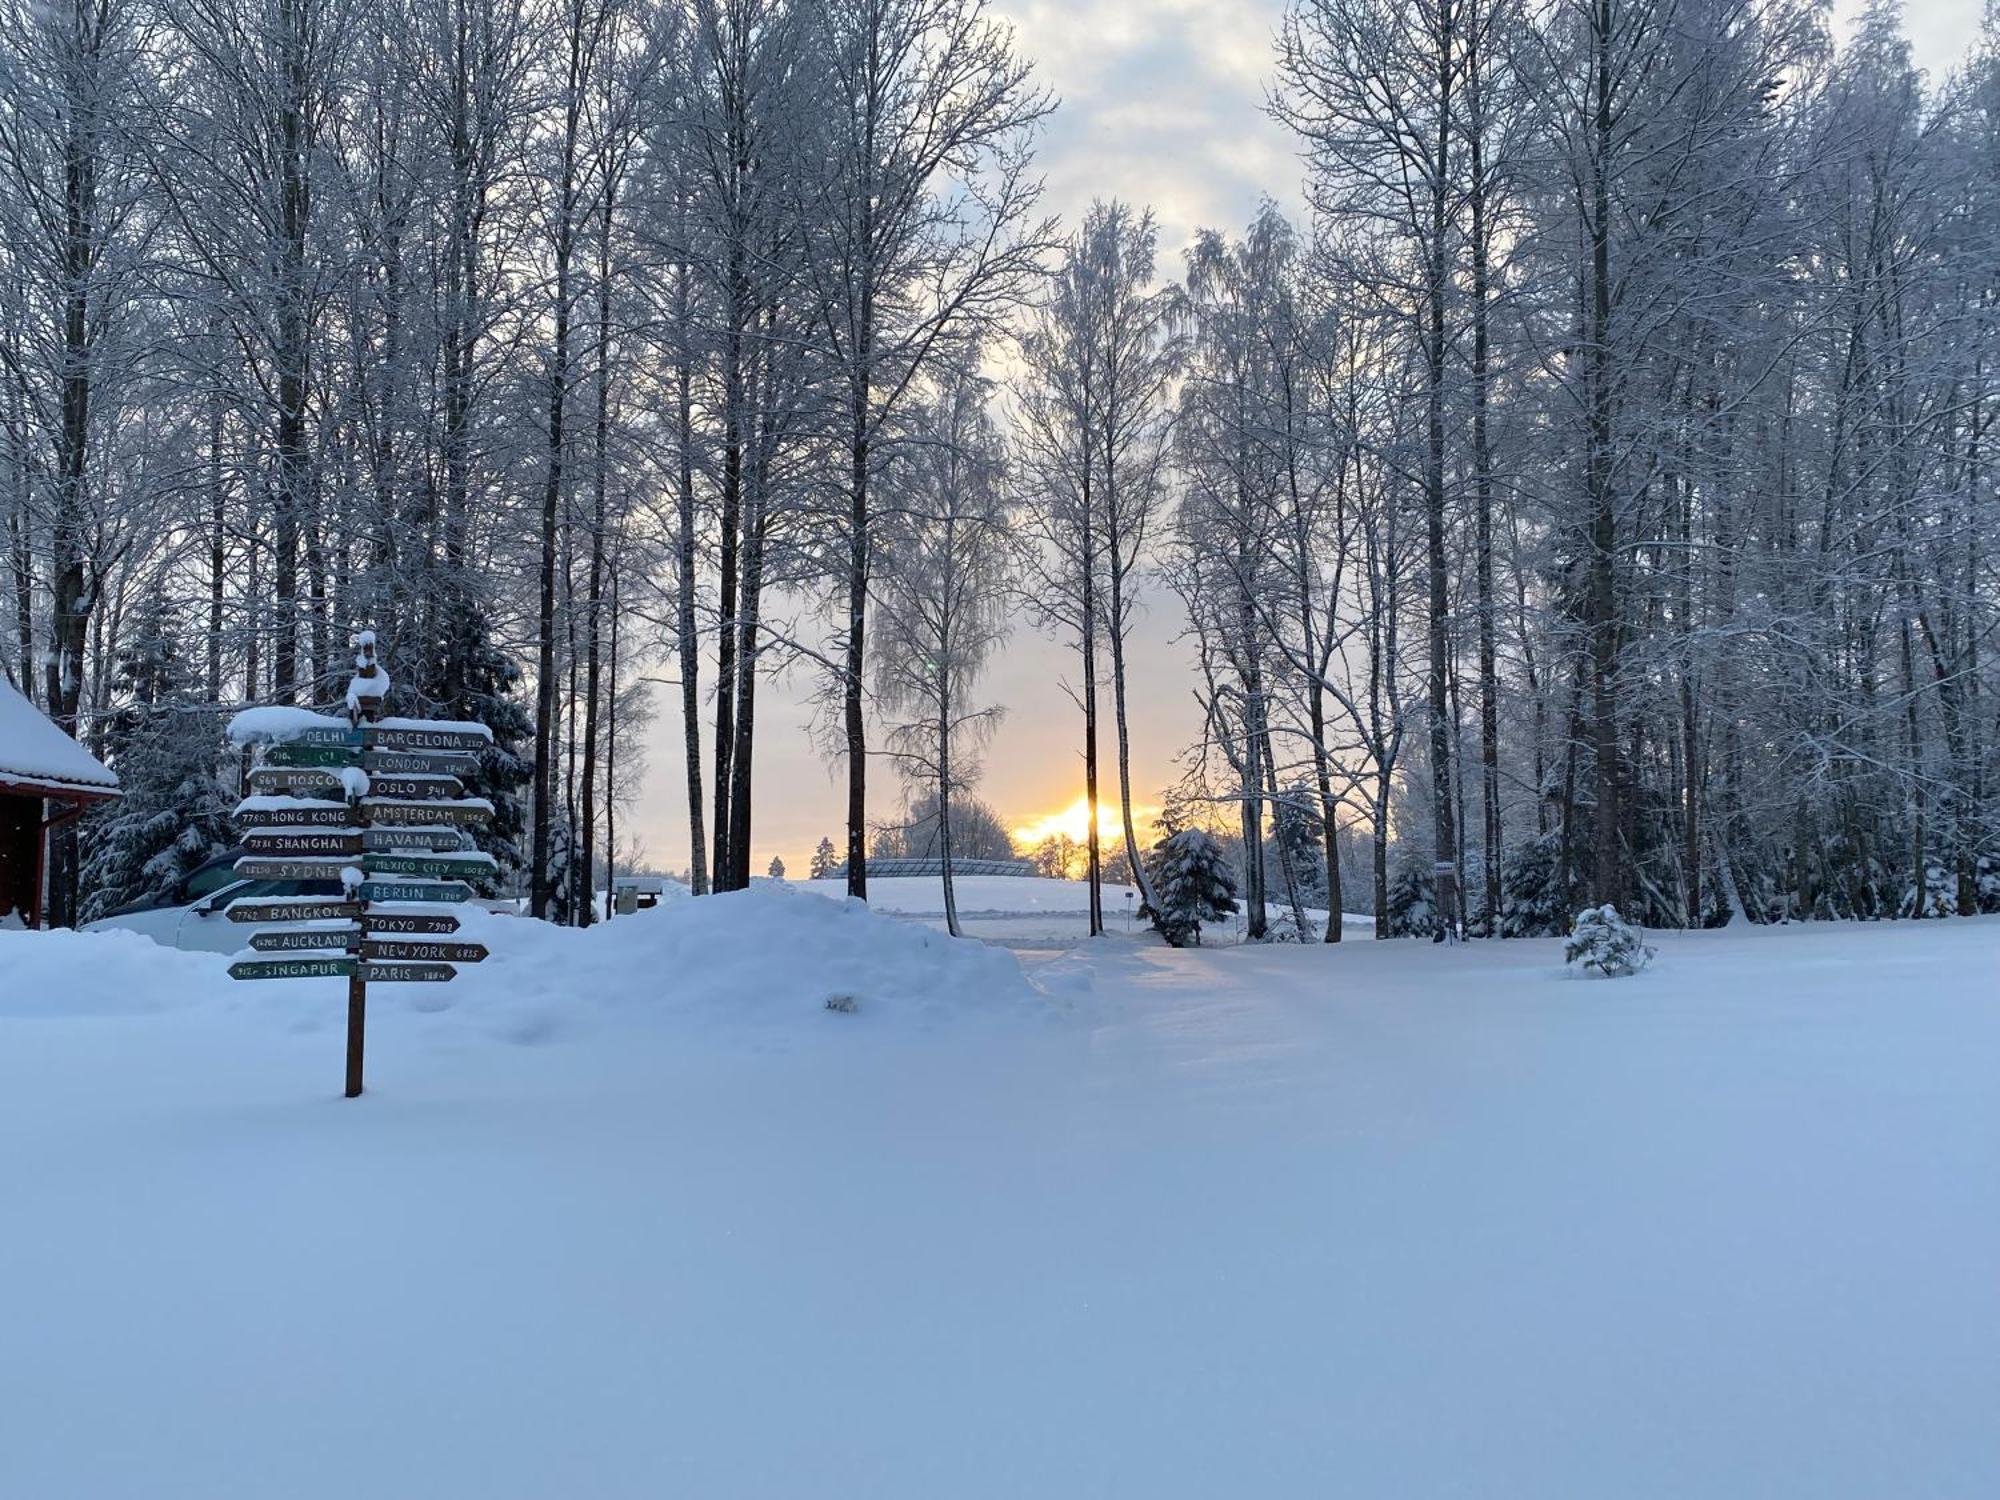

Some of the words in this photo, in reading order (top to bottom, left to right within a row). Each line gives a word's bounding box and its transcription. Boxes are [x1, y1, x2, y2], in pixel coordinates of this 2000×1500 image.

[307, 731, 345, 742] DELHI
[377, 733, 462, 747] BARCELONA
[378, 758, 431, 770] LONDON
[288, 775, 341, 786] MOSCO
[377, 783, 416, 793] OSLO
[427, 786, 445, 795] 941
[271, 812, 305, 822] HONG
[312, 811, 346, 822] KONG
[373, 807, 454, 821] AMSTERDAM
[276, 838, 344, 849] SHANGHAI
[374, 833, 433, 846] HAVANA
[280, 864, 340, 878] SYDNE
[375, 861, 416, 871] MEXICO
[423, 863, 450, 874] CITY
[373, 886, 424, 899] BERLIN
[270, 907, 341, 919] BANGKOK
[369, 918, 415, 930] TOKYO
[427, 922, 453, 933] 7902
[282, 935, 348, 948] AUCKLAND
[378, 945, 407, 956] NEW
[412, 946, 446, 959] YORK
[265, 964, 338, 976] SINGAPUR
[370, 968, 411, 980] PARIS
